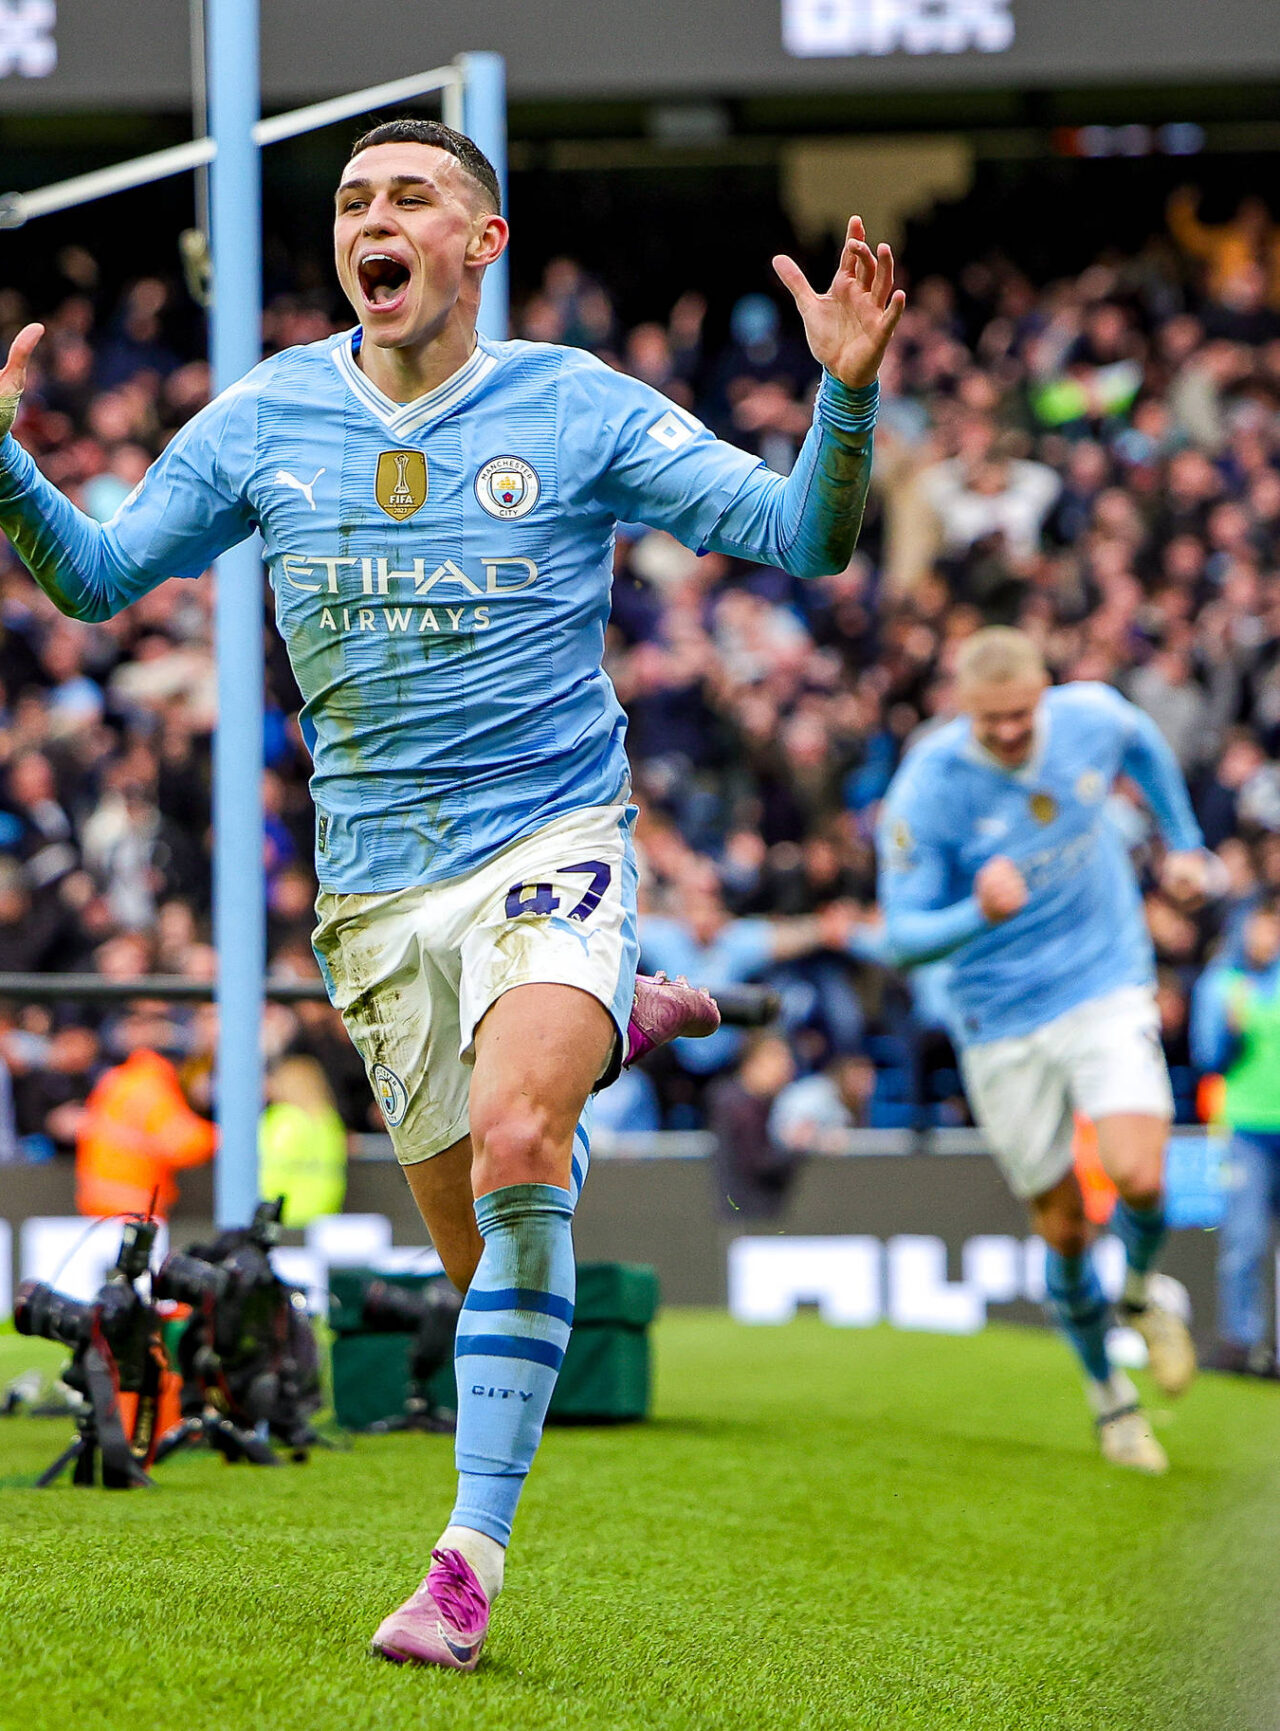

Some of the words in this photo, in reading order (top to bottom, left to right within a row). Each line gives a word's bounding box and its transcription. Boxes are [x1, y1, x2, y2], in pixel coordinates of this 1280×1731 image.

[481, 460, 534, 480] MANCHESTER
[389, 495, 413, 504] FIFA
[499, 509, 518, 517] CITY
[282, 554, 538, 595] ETIHAD
[319, 606, 490, 632] AIRWAYS
[505, 860, 612, 922] 47
[471, 1385, 533, 1402] CITY
